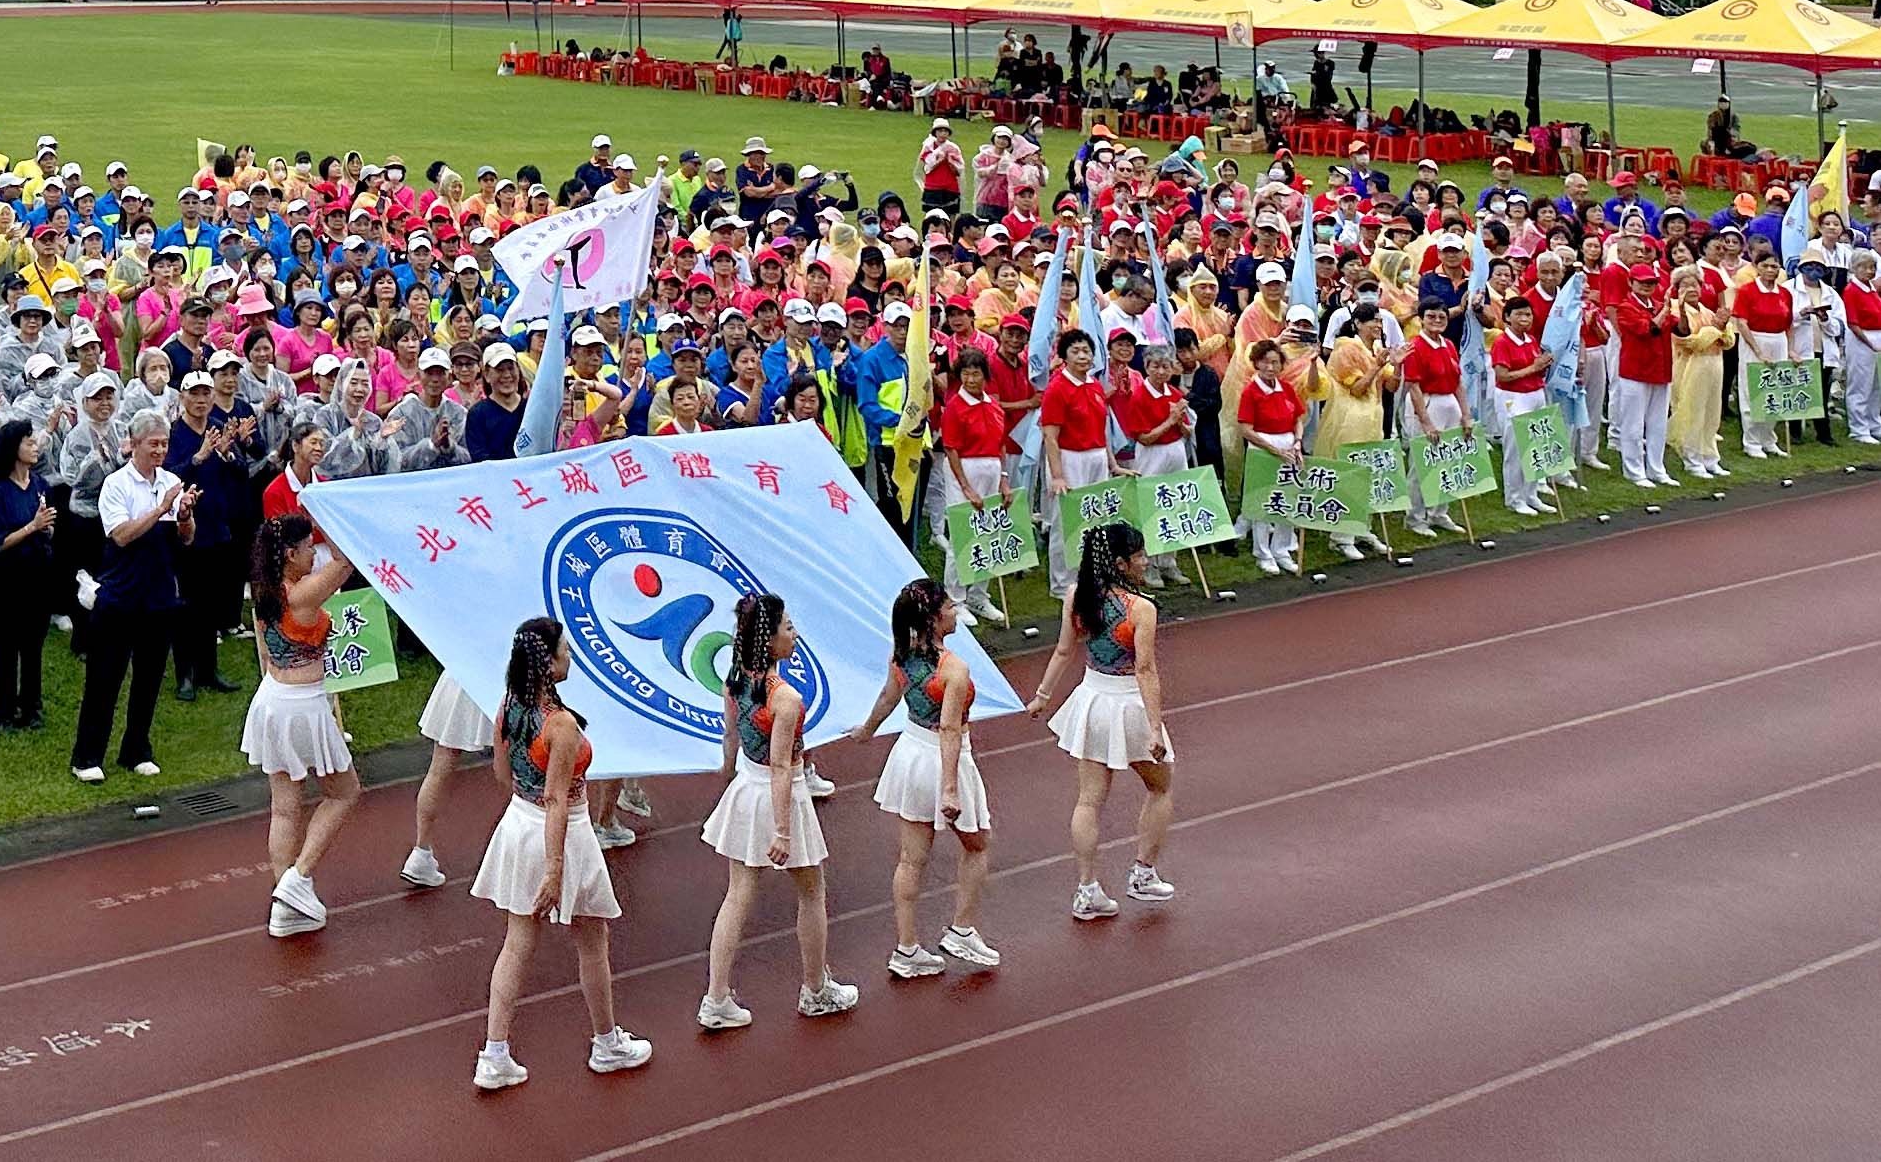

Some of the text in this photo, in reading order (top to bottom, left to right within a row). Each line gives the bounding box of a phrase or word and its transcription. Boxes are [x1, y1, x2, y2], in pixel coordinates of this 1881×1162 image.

[1763, 390, 1812, 416] 委員會
[1531, 441, 1564, 472] 委員會
[1277, 464, 1339, 492] 武術
[1439, 462, 1478, 493] 委員會
[1155, 480, 1201, 510] 香功
[1263, 490, 1350, 524] 委員會
[368, 448, 858, 595] 新北市土城區體育會
[970, 505, 1014, 537] 慢跑
[1157, 507, 1218, 543] 委員會
[969, 536, 1023, 573] 委員會
[575, 612, 656, 699] Tucheng
[667, 696, 726, 729] Distri
